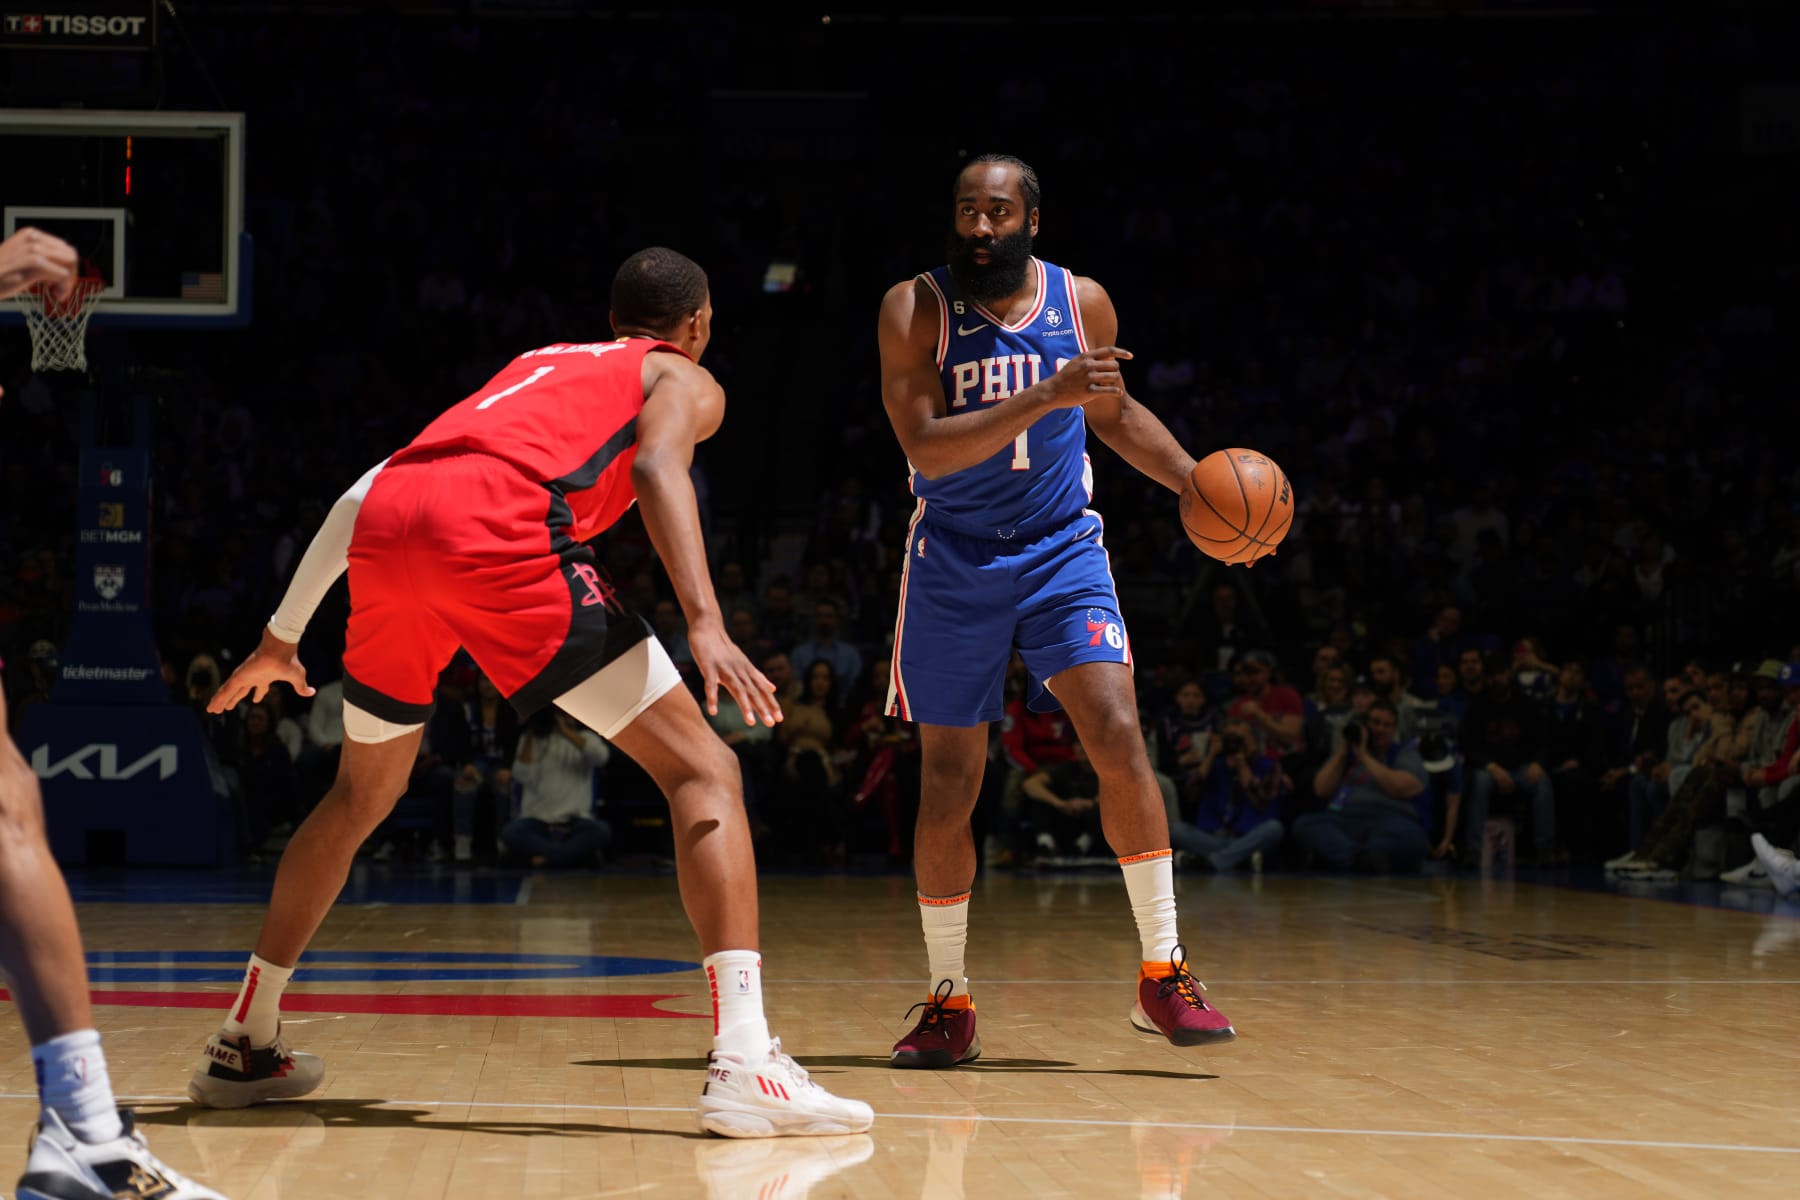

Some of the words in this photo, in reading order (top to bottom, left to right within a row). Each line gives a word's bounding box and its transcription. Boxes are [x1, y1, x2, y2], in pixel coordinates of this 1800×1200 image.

[44, 15, 146, 36] TISSOT
[953, 301, 965, 315] 6
[475, 365, 555, 410] 1
[952, 354, 1070, 408] PHIL
[80, 528, 142, 544] BETMGM
[1087, 621, 1123, 650] 76
[62, 664, 148, 681] ticketmaster
